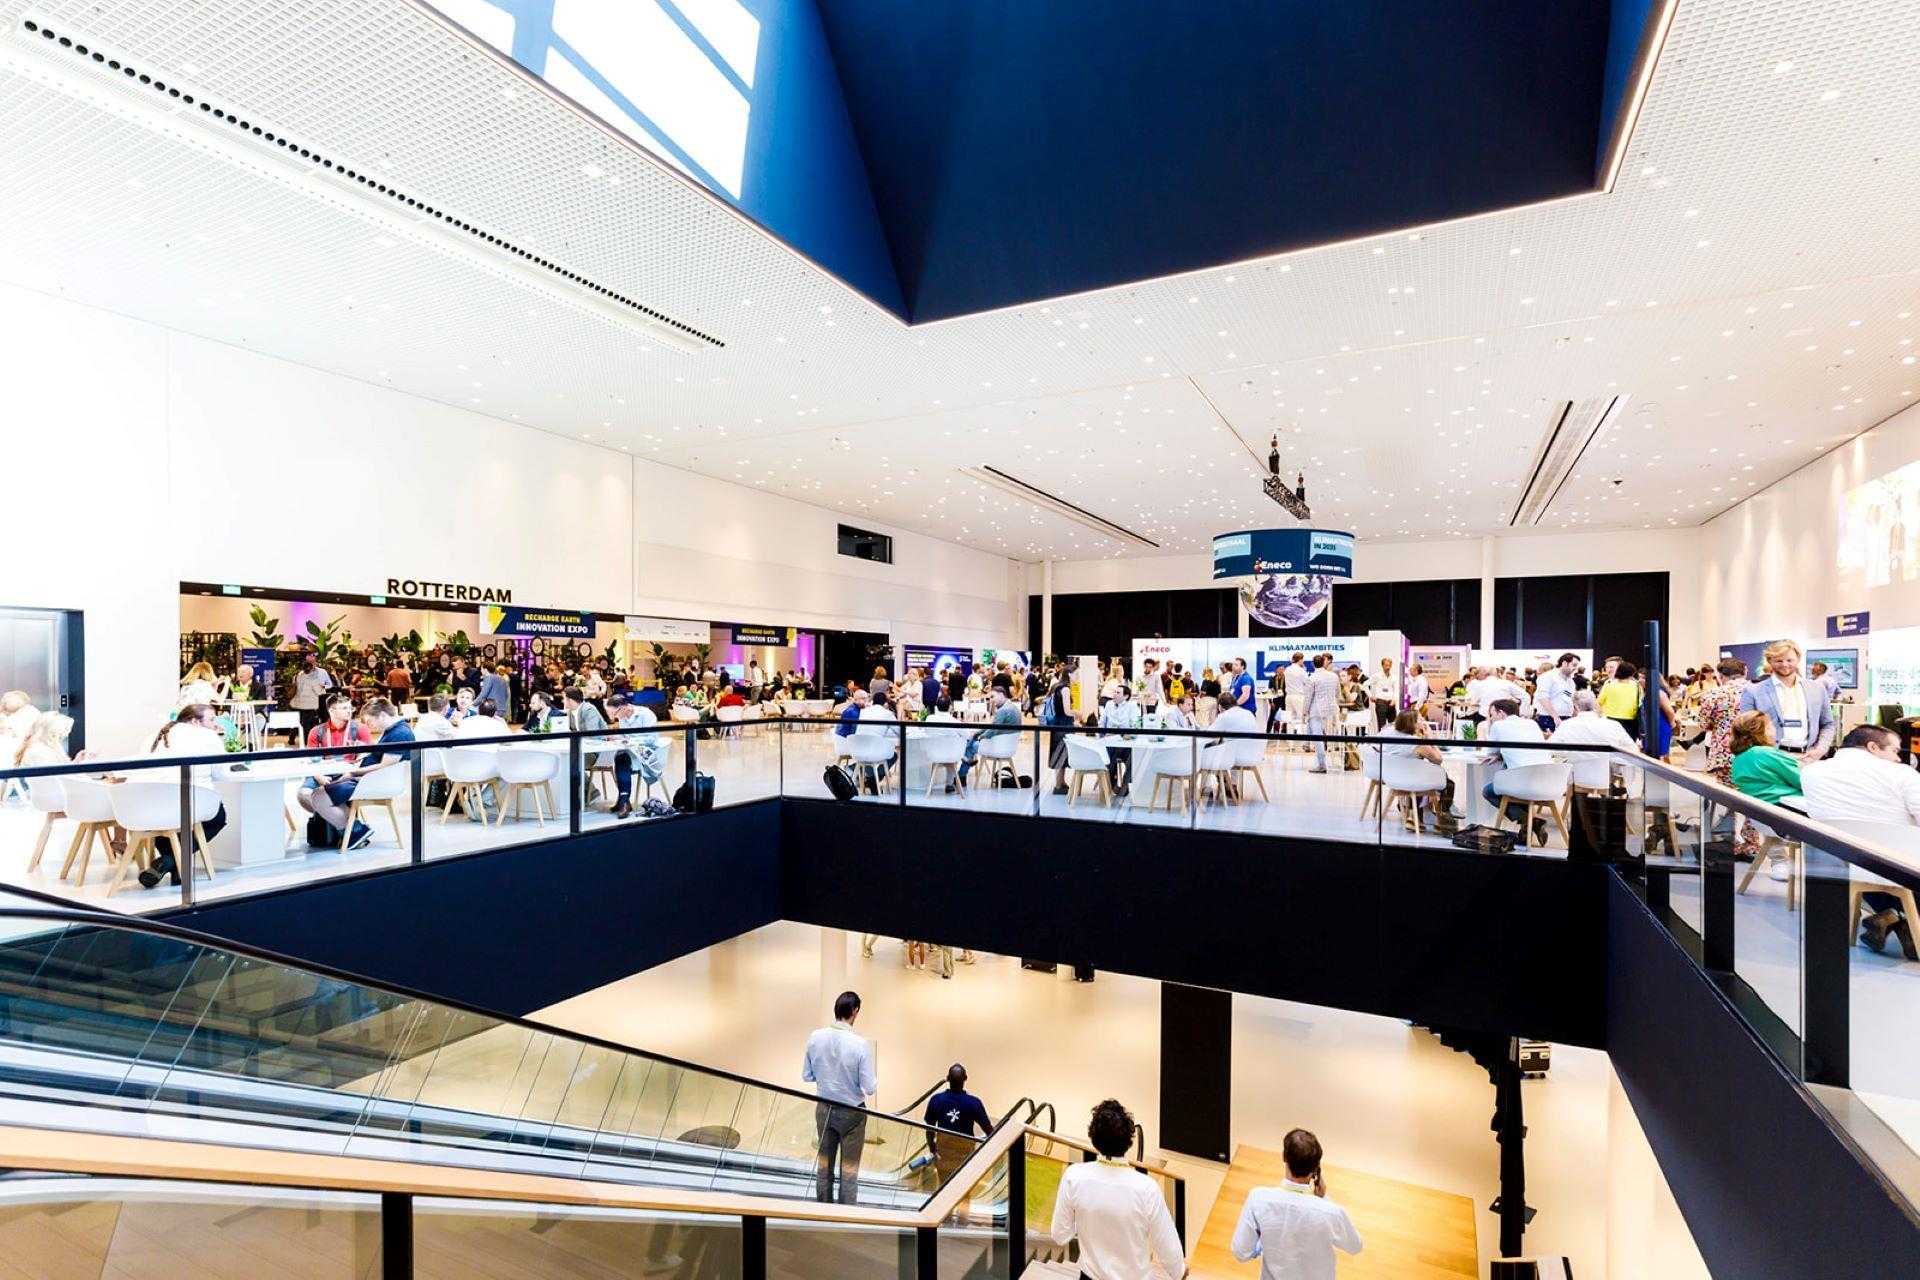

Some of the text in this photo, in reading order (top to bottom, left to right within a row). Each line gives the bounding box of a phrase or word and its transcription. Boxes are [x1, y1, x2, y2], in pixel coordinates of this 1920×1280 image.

[1262, 560, 1292, 570] Eneco
[387, 578, 512, 603] ROTTERDAM
[524, 613, 581, 623] RECHARGE EARTH
[516, 622, 589, 634] INNOVATION EXPO
[1145, 645, 1170, 653] Eneco
[1268, 644, 1345, 652] KLIMAATAMBITIES
